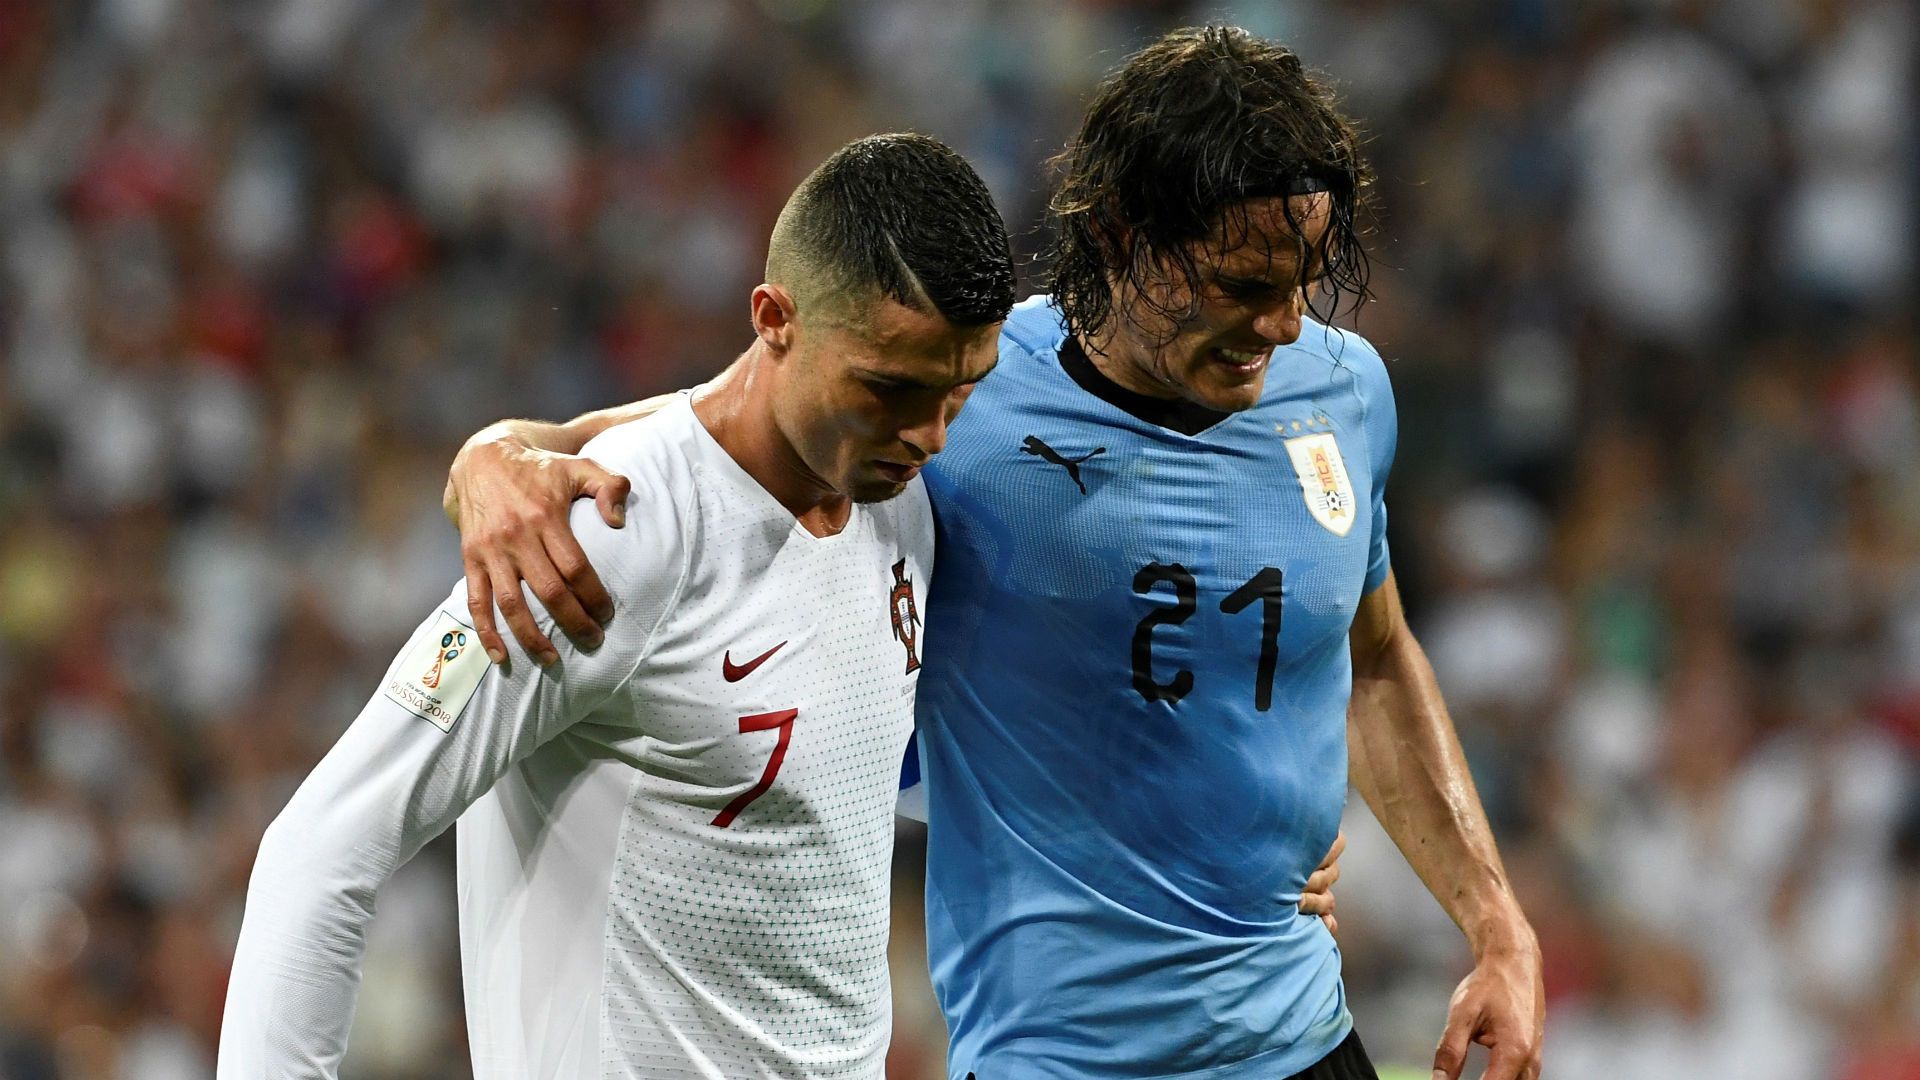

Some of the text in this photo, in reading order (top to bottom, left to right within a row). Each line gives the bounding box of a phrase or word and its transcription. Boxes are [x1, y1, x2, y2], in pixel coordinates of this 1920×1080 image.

[1315, 453, 1333, 487] AUF
[1131, 561, 1282, 712] 21
[391, 681, 451, 724] RUSSIA 2018
[710, 707, 798, 828] 7
